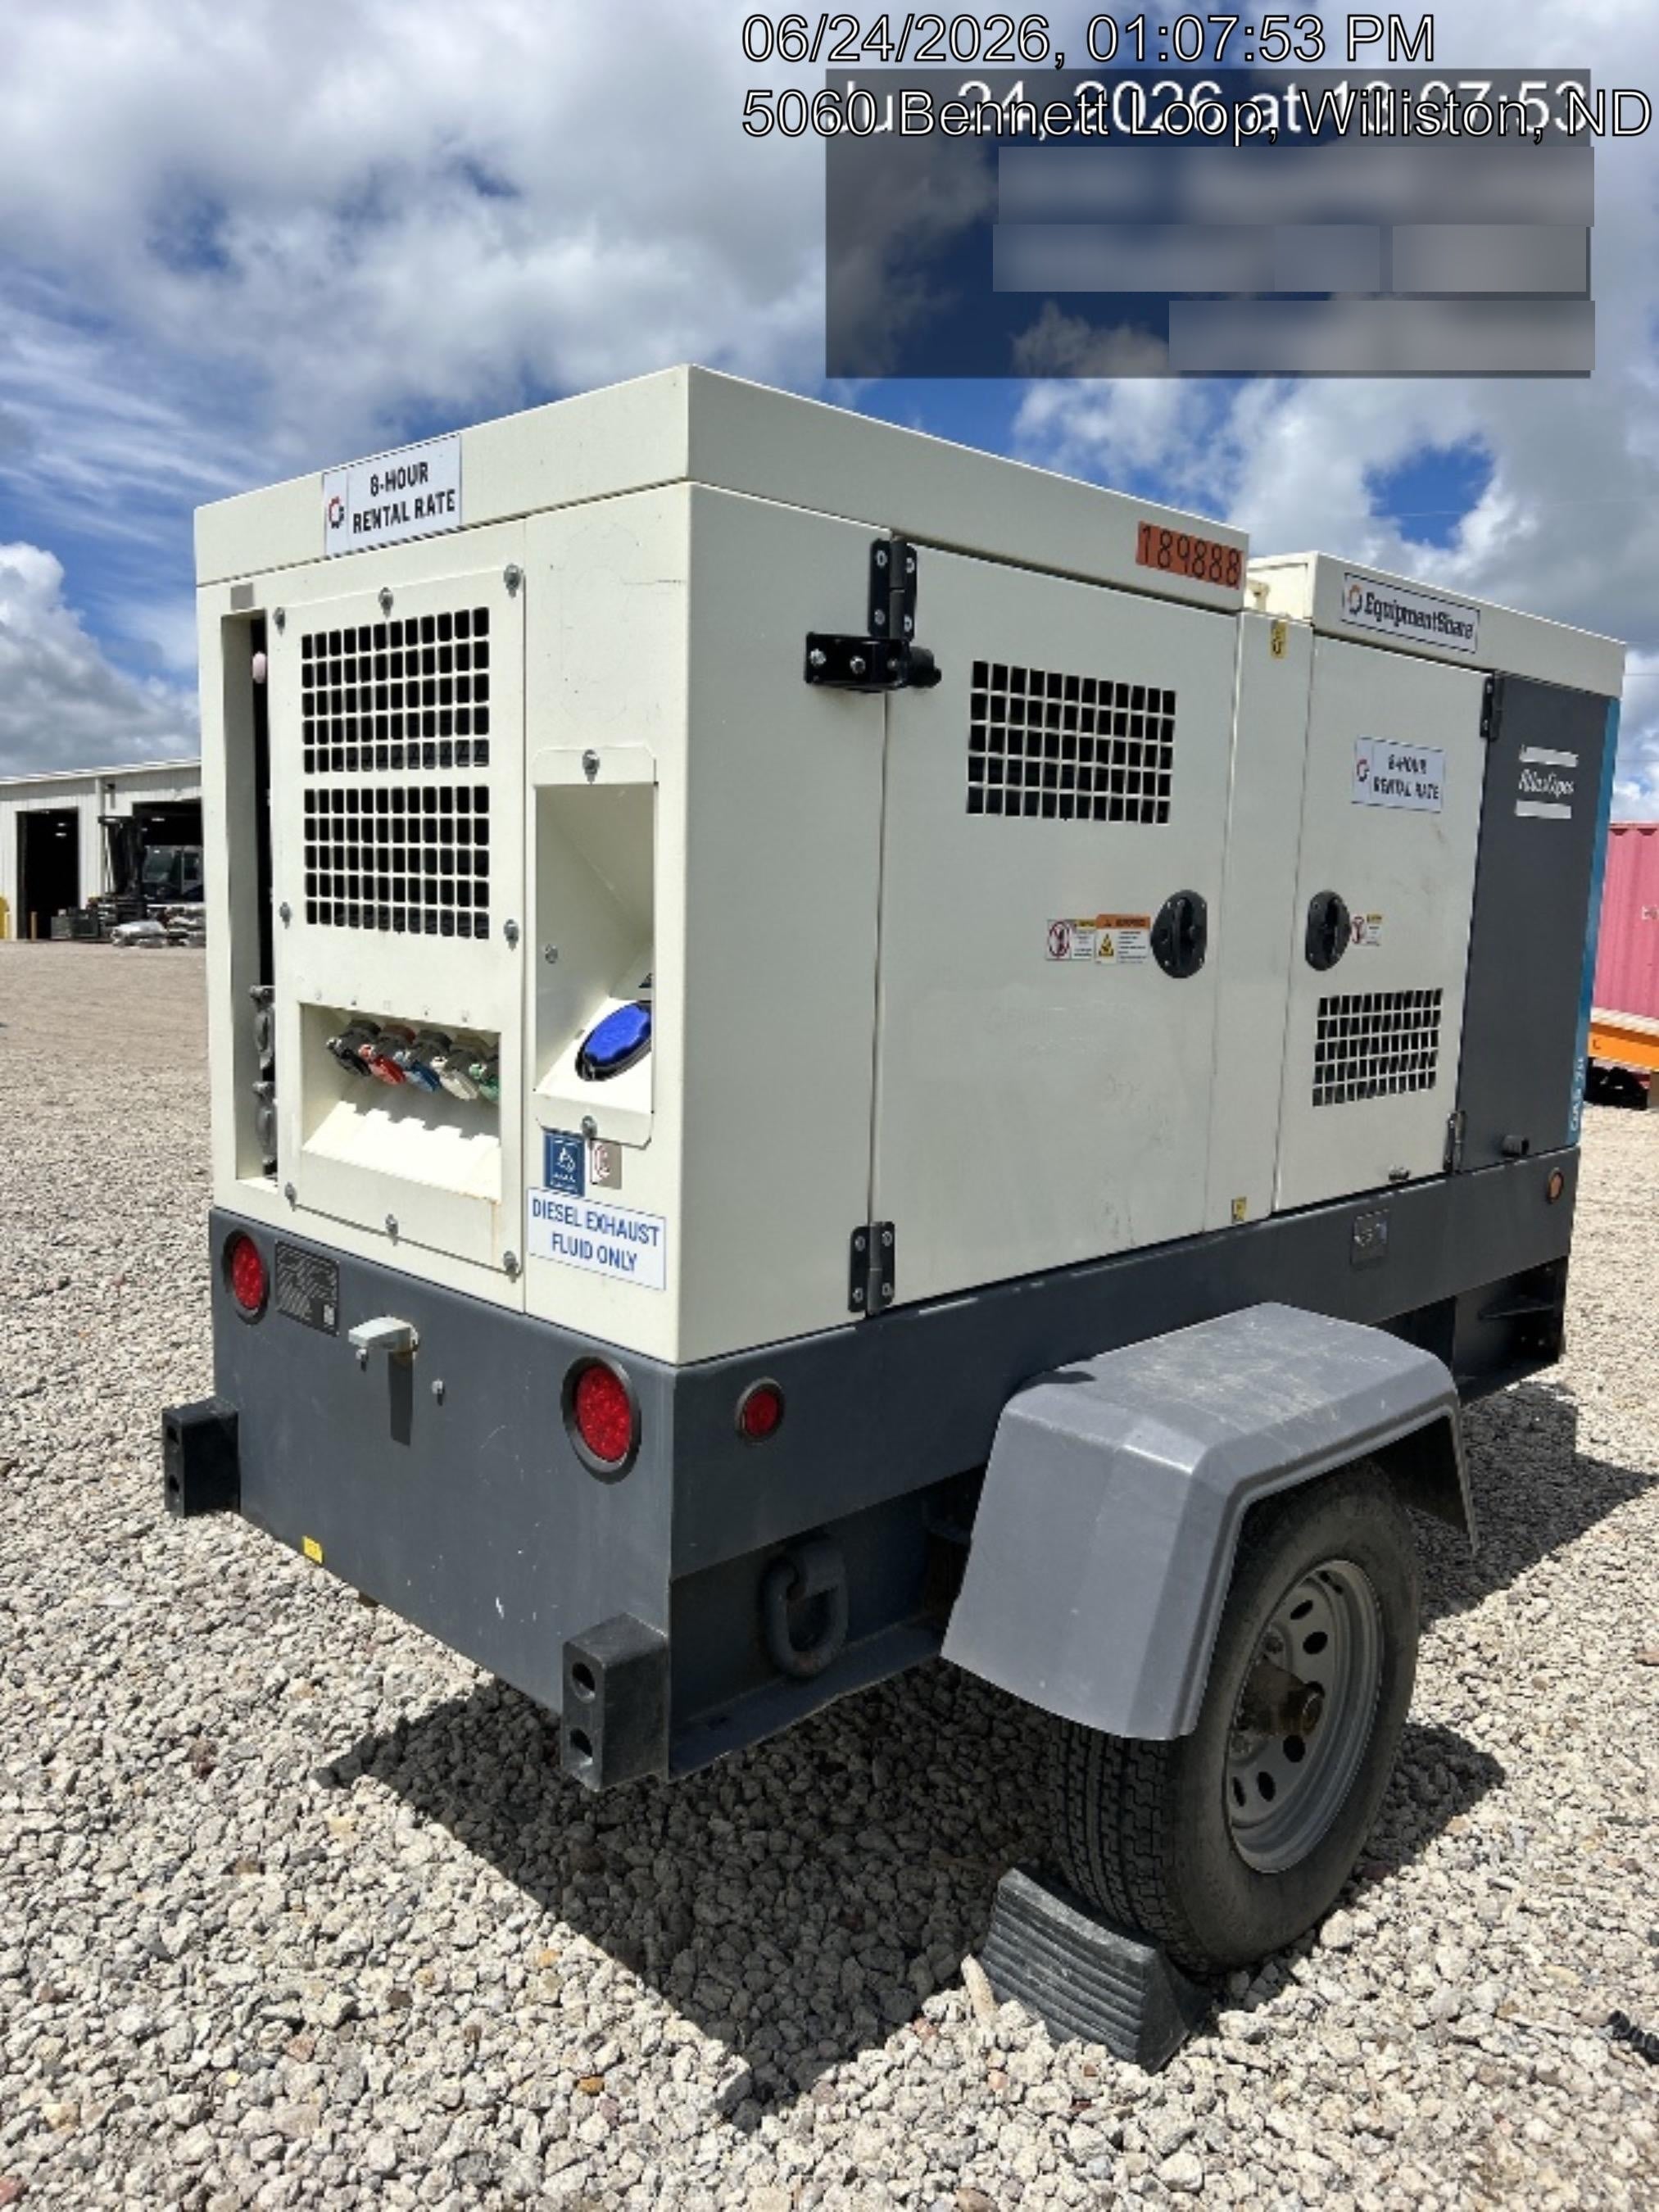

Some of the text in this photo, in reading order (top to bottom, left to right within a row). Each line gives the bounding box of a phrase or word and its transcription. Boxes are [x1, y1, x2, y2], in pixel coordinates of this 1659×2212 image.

[370, 461, 428, 496] 8-HOUR
[353, 489, 456, 534] RENTAL RATE
[1142, 525, 1240, 587] 189888
[1364, 592, 1475, 640] EquipmentShare
[532, 1197, 660, 1247] DIESEL EXHAUST
[551, 1231, 637, 1272] FLUID ONLY
